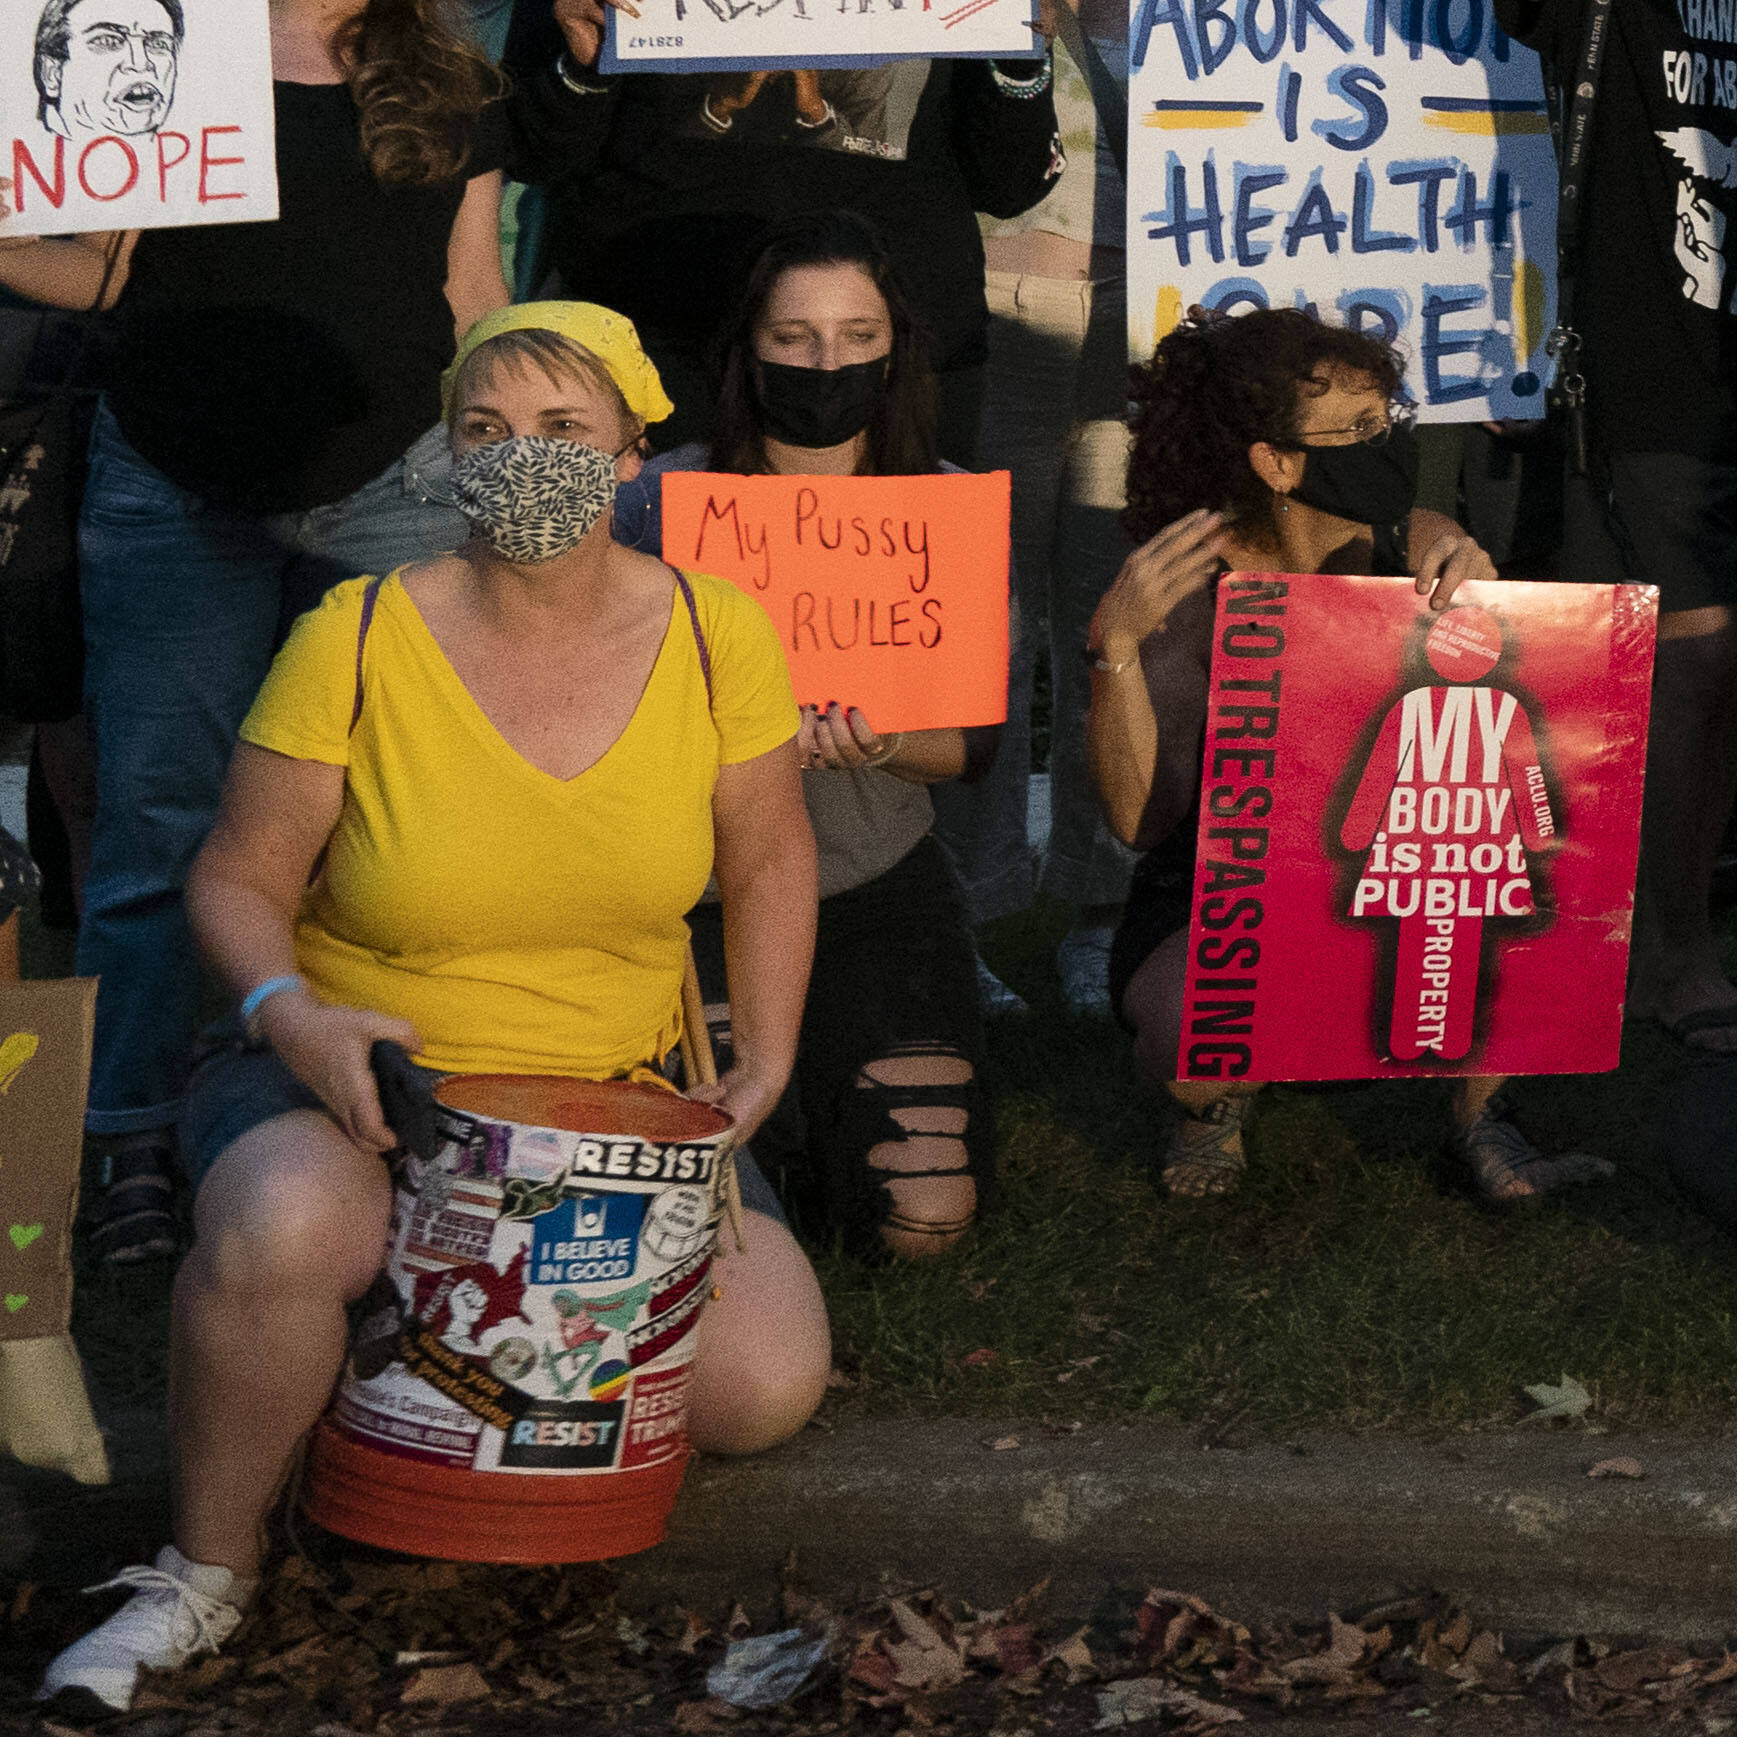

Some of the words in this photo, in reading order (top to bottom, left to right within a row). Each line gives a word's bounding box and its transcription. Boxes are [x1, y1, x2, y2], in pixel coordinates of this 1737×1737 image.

[1276, 61, 1390, 153] IS
[1662, 49, 1709, 106] FOR
[10, 124, 250, 215] NOPE
[1142, 148, 1534, 268] HEALTH
[695, 494, 772, 591] My
[795, 487, 932, 594] Pussy
[792, 591, 943, 654] RULES
[1220, 577, 1290, 660] NO
[1396, 685, 1519, 785] MY
[1387, 787, 1513, 837] BODY
[1523, 763, 1558, 839] ACLU.ORG
[1186, 668, 1283, 1080] TRESPASSING
[1370, 831, 1423, 874] is
[1428, 832, 1527, 875] not
[1353, 877, 1531, 918] PUBLIC
[1416, 916, 1455, 1052] PROPERTY
[570, 1138, 715, 1184] RESIST
[537, 1264, 564, 1282] IN
[566, 1260, 630, 1282] GOOD
[553, 1238, 631, 1260] BELIEVE
[510, 1420, 617, 1446] RESIST
